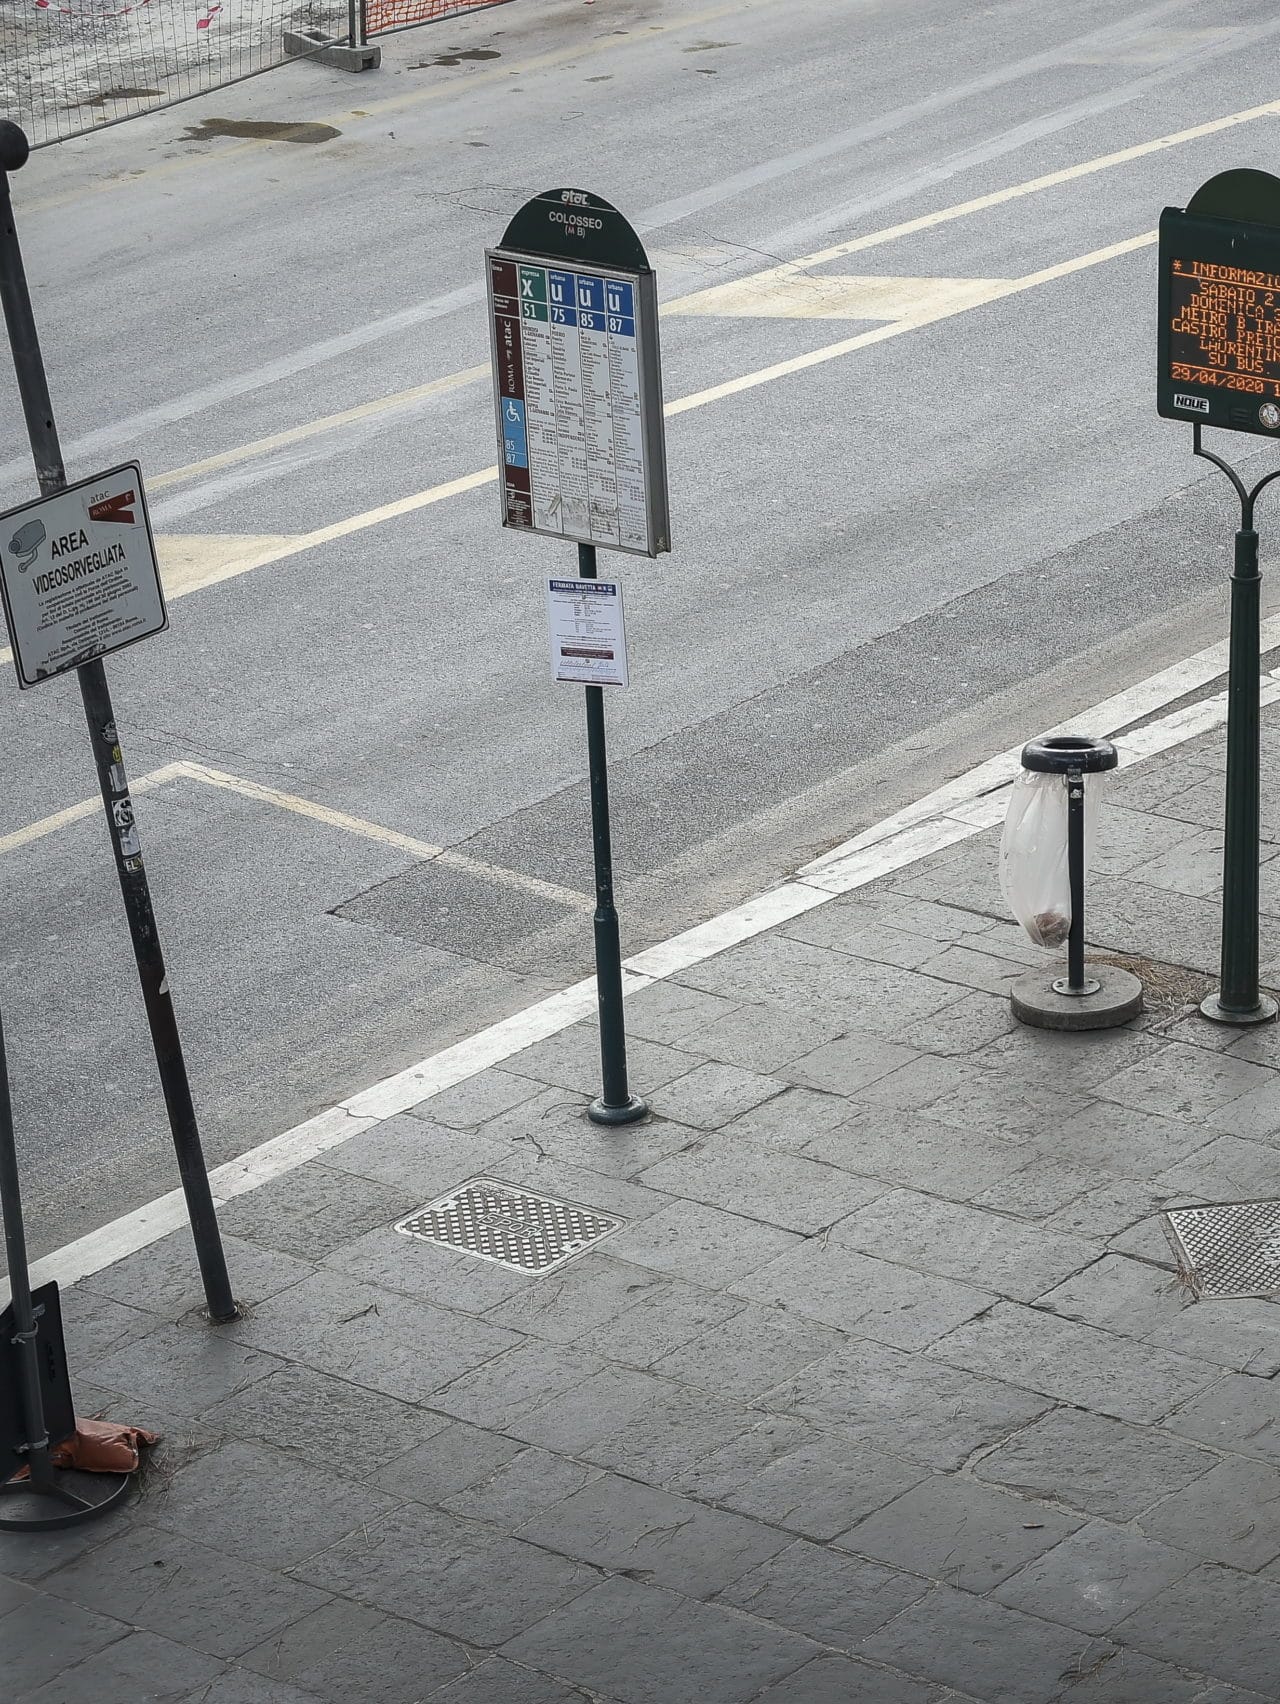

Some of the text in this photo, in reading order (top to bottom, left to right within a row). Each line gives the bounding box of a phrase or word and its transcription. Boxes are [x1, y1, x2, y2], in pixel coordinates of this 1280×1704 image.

[561, 189, 589, 205] atac
[549, 211, 602, 230] COLOSSEO
[1200, 281, 1256, 303] SABATO
[1264, 292, 1274, 306] 2
[524, 303, 537, 318] 51
[552, 307, 565, 323] 75
[1190, 294, 1265, 319] DOMENICA
[581, 313, 593, 328] 85
[609, 317, 622, 332] 87
[1181, 305, 1227, 326] METRO
[1236, 316, 1246, 330] B
[504, 320, 512, 347] atac
[1172, 318, 1227, 340] CASTRO
[1208, 352, 1227, 367] SU
[507, 363, 515, 393] ROMA
[1171, 366, 1264, 394] 29/04/2020
[506, 439, 514, 451] 85
[506, 453, 515, 464] 87
[90, 490, 110, 504] atac
[92, 504, 113, 517] ROMA
[51, 529, 89, 560] AREA
[32, 543, 126, 595] VIDEOSORVEGLIATA
